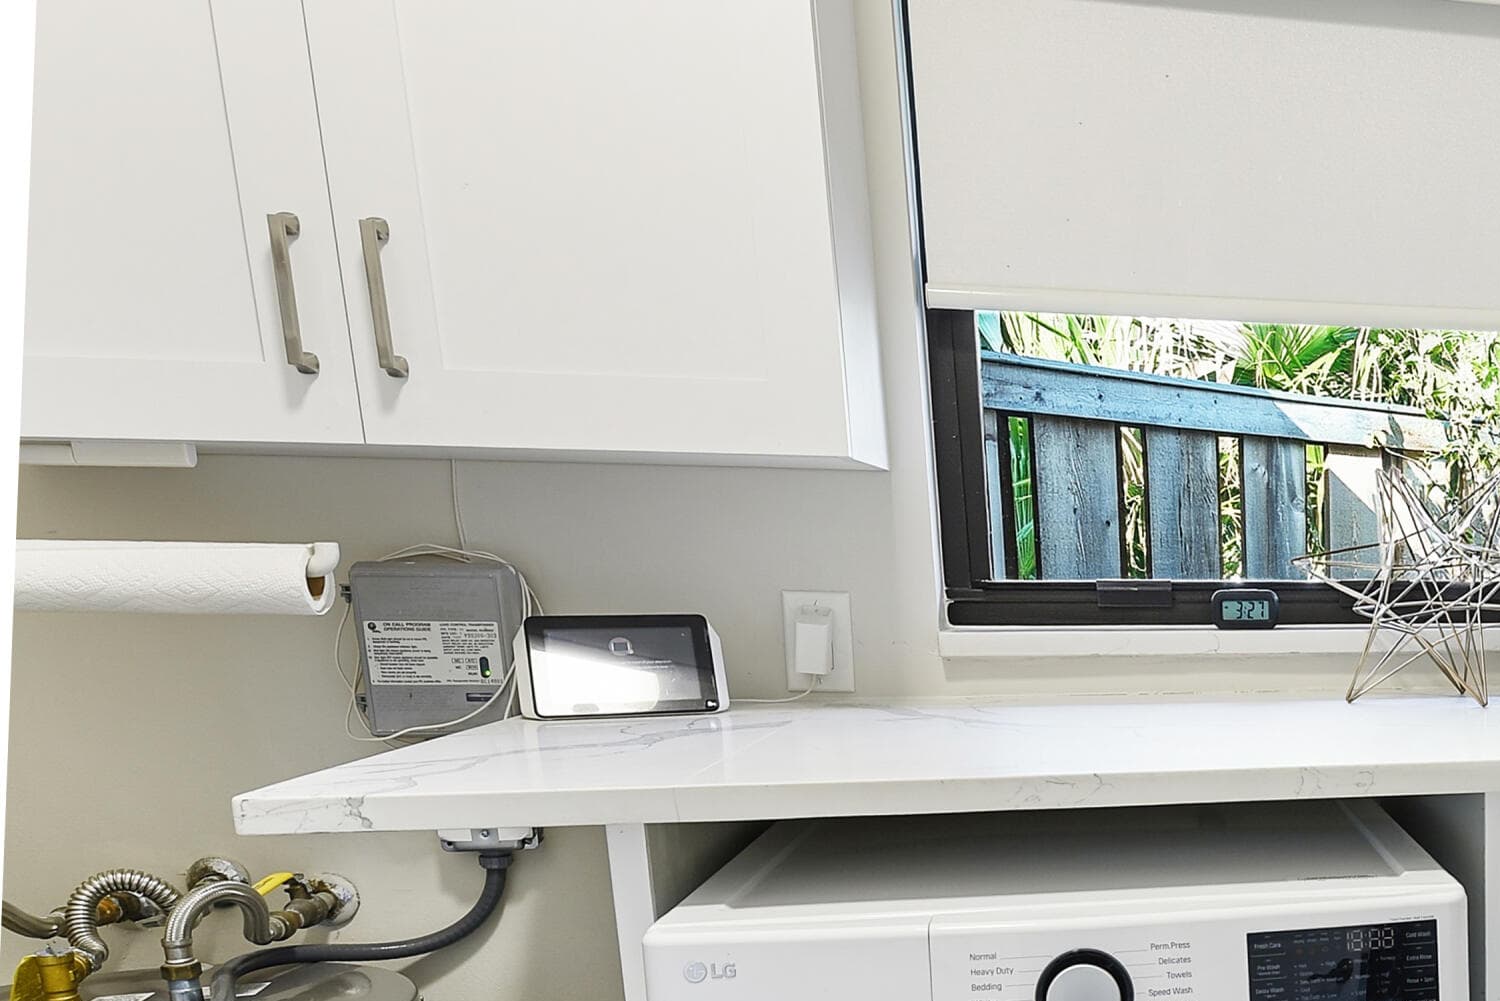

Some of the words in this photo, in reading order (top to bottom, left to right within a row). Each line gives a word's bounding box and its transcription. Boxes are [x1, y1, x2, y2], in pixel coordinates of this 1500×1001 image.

[1236, 601, 1264, 618] 3:27
[969, 952, 997, 960] Normal
[1158, 957, 1192, 965] Delicates
[996, 967, 1014, 975] Duty
[971, 983, 1003, 992] Bedding
[1148, 989, 1171, 998] Speed
